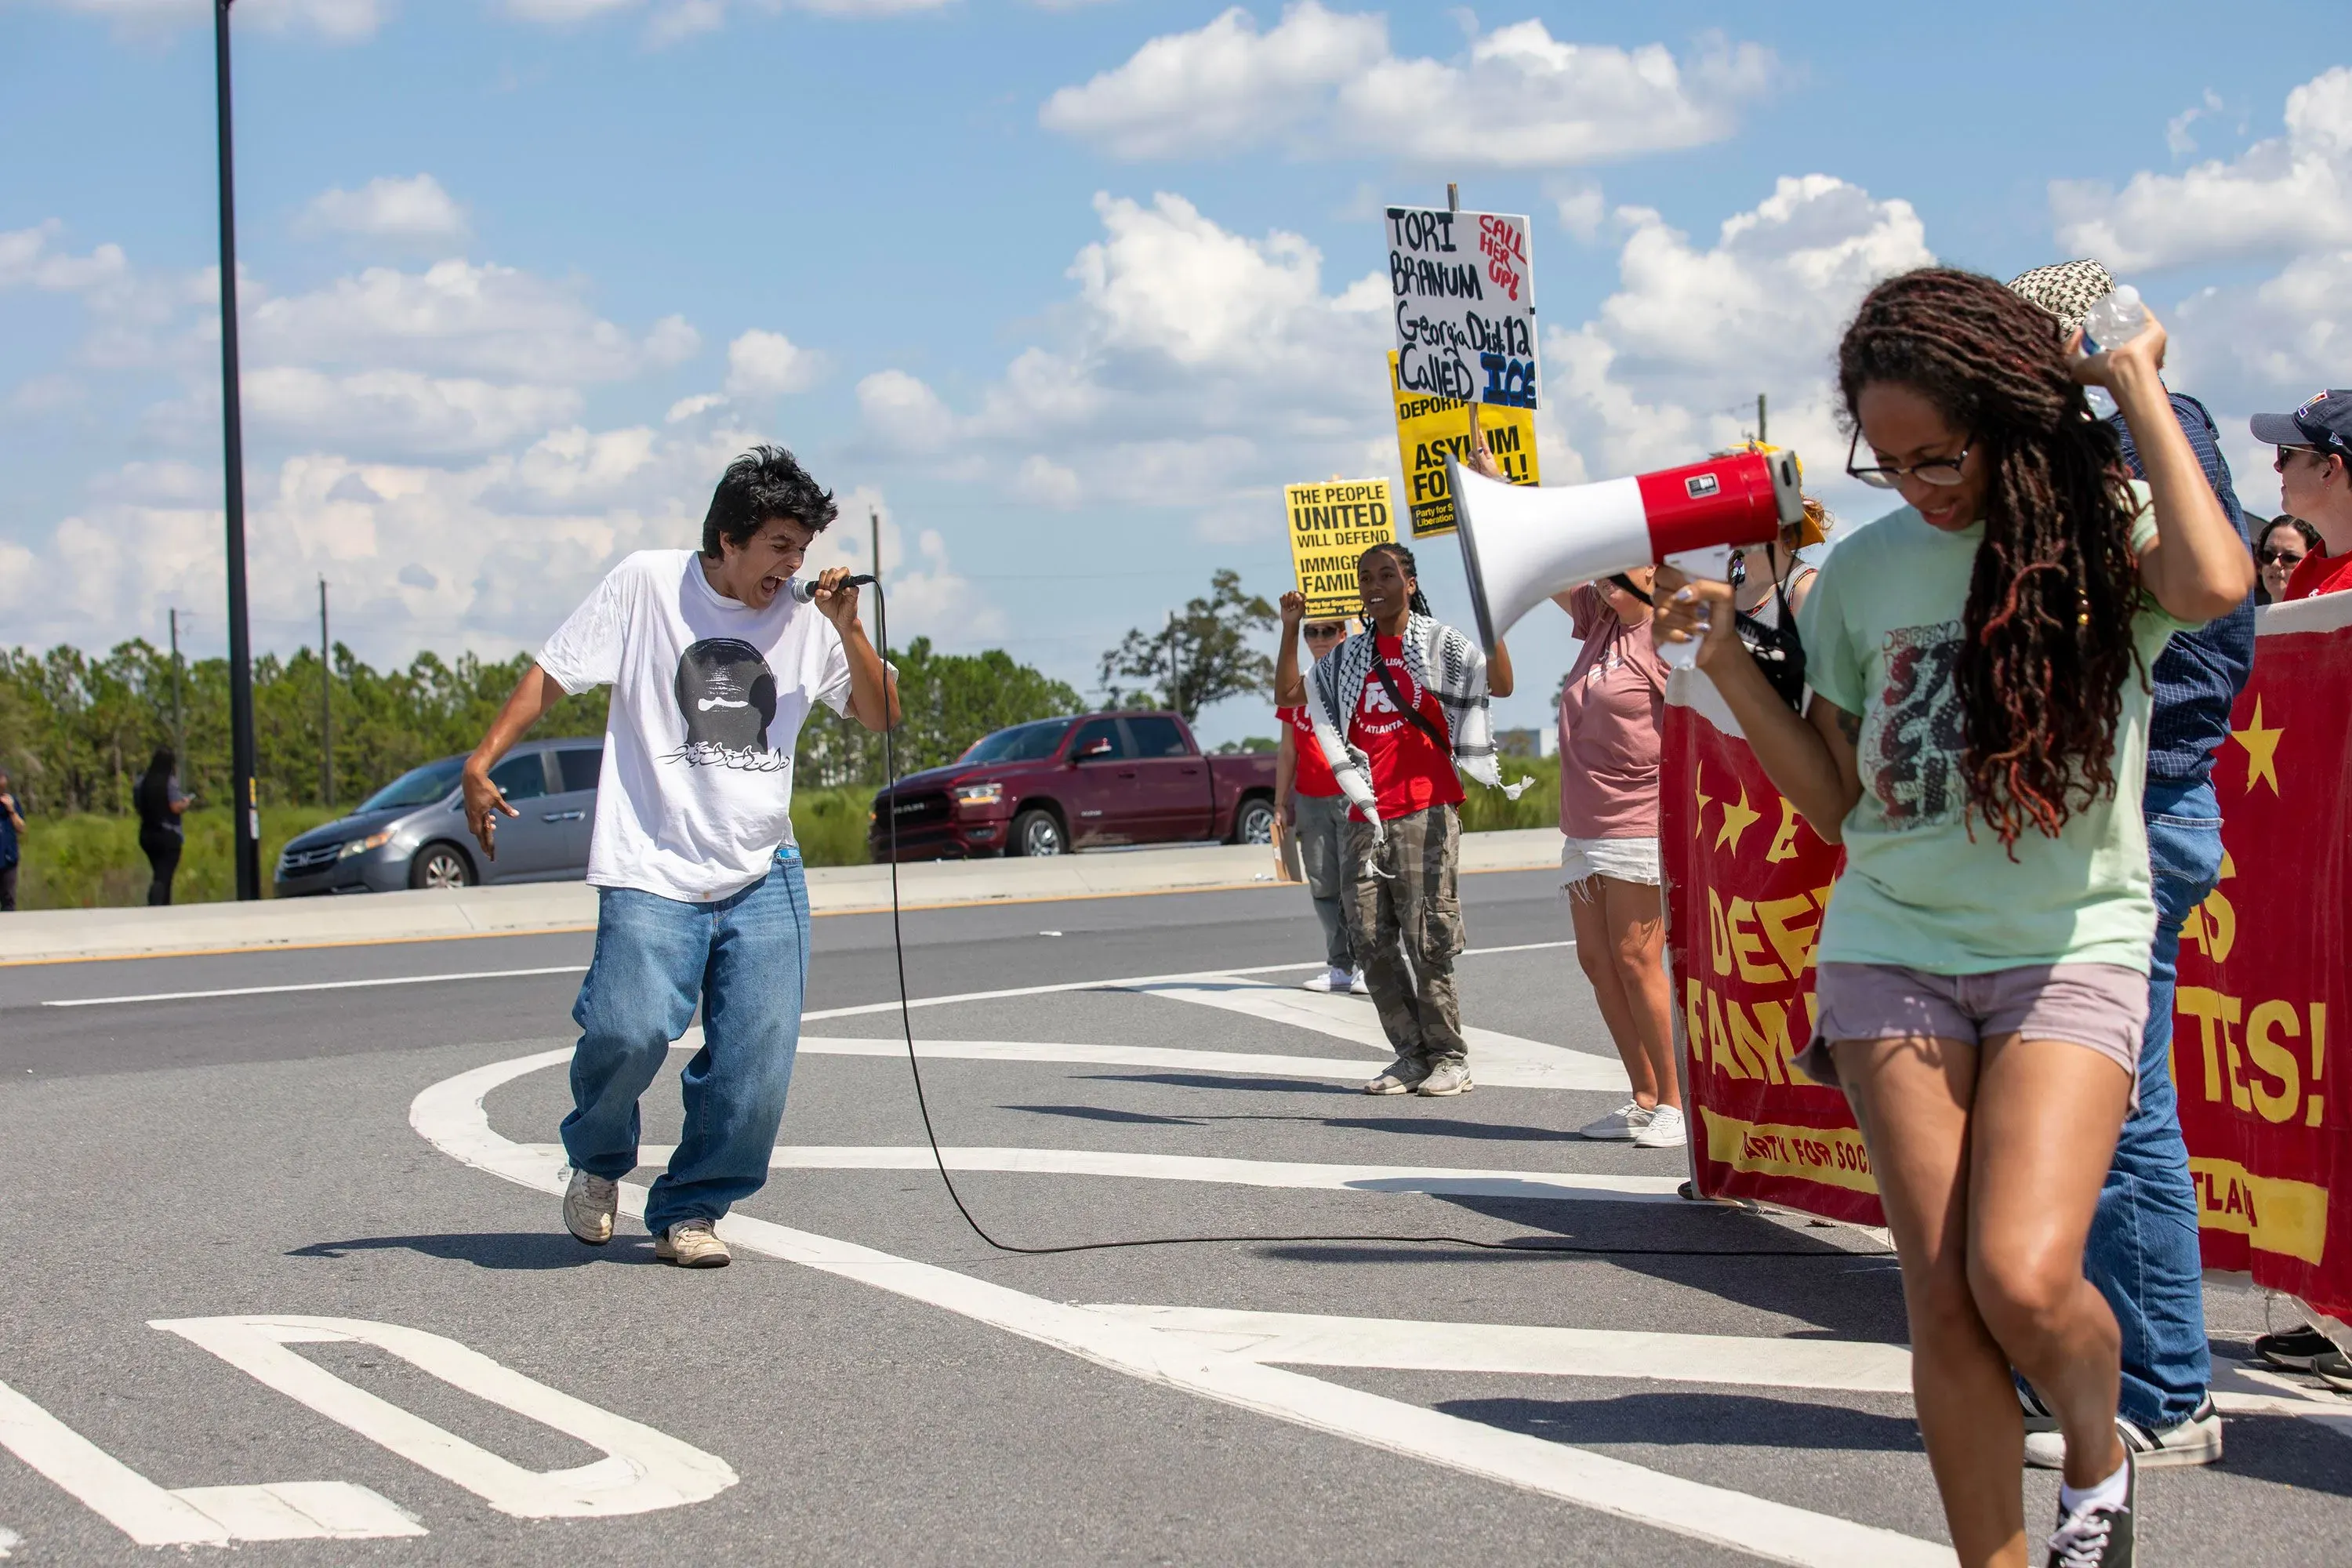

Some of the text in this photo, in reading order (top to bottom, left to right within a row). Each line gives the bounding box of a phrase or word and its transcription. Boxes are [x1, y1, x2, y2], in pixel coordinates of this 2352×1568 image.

[1387, 208, 1457, 252] TORI
[1479, 215, 1527, 265] CALL
[1479, 232, 1512, 274] HER
[1390, 250, 1483, 300] BRANUM
[1489, 260, 1520, 301] UP!
[1397, 300, 1472, 359] Georgia
[1503, 315, 1532, 358] 12
[1291, 485, 1385, 505] THE PEOPLE
[1416, 507, 1436, 519] Party
[1436, 504, 1447, 514] for
[1294, 503, 1387, 532] UNITED
[1417, 514, 1454, 528] Liberation
[1298, 529, 1389, 548] WILL DEFEND
[1364, 720, 1404, 734] ATLANTA
[2174, 986, 2326, 1127] TES!
[1791, 1138, 1833, 1167] FOR
